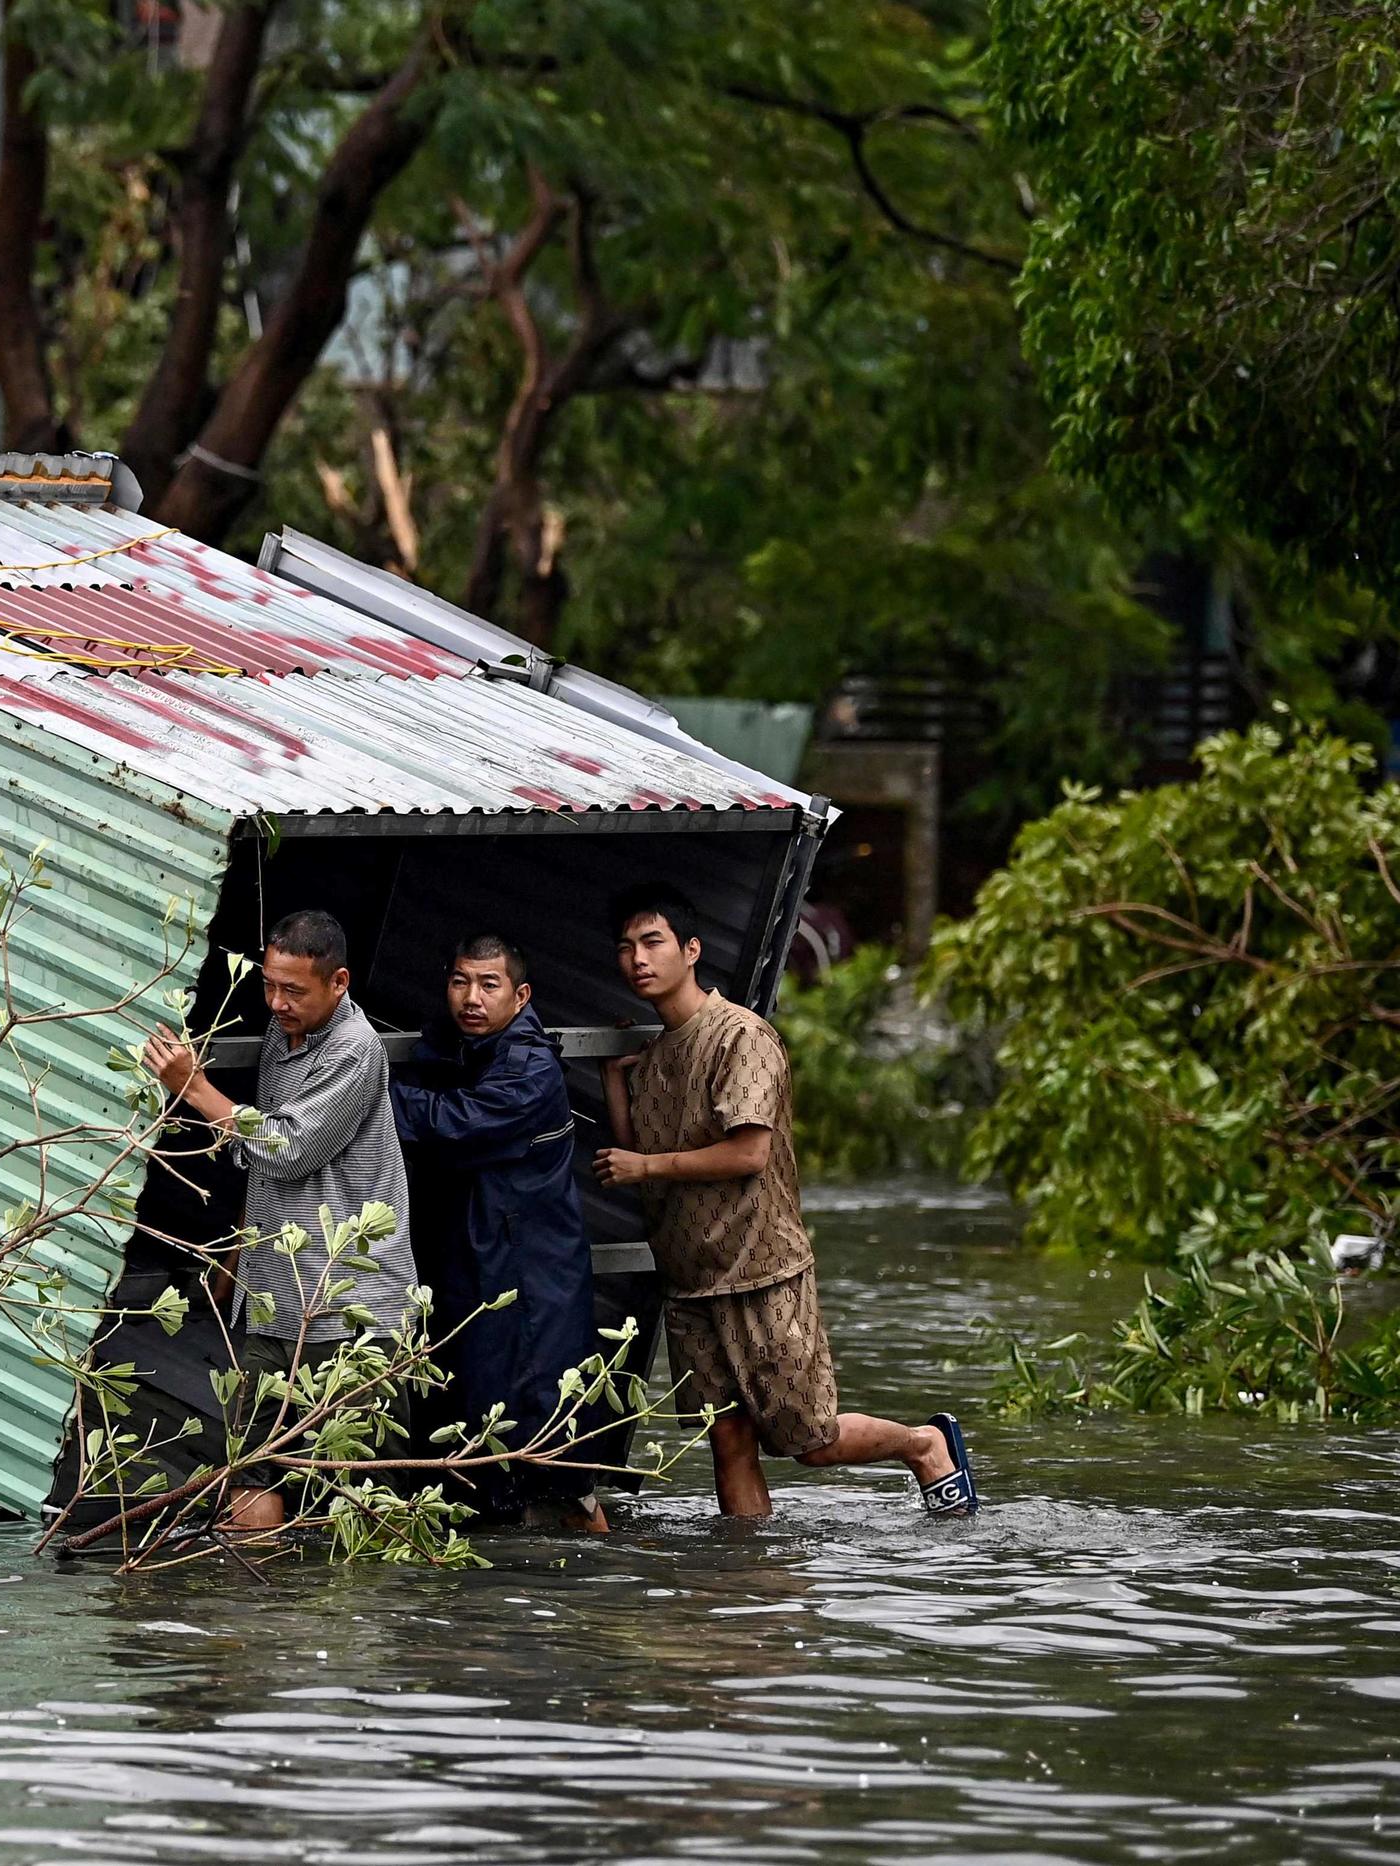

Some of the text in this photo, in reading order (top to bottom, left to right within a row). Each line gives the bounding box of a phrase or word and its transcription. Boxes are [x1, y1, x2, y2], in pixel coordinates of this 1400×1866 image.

[751, 1038, 757, 1051] U
[742, 1055, 747, 1066] B
[761, 1057, 766, 1069] B
[752, 1071, 758, 1083] U
[662, 1080, 668, 1093] U
[691, 1078, 698, 1090] U
[742, 1087, 749, 1098] B
[733, 1103, 760, 1116] U U
[643, 1112, 698, 1127] U U U
[683, 1129, 690, 1142] B
[760, 1178, 766, 1190] B
[698, 1194, 704, 1206] B
[690, 1197, 759, 1224] U U U U
[704, 1227, 710, 1239] B
[724, 1221, 730, 1234] B
[716, 1230, 765, 1252] U U U
[749, 1243, 774, 1261] B B
[709, 1274, 716, 1286] U
[739, 1267, 747, 1279] U
[761, 1262, 767, 1275] U
[763, 1290, 792, 1305] U U
[794, 1289, 800, 1302] B
[720, 1312, 726, 1325] B
[776, 1308, 782, 1321] B
[732, 1328, 773, 1342] U U U
[804, 1322, 810, 1335] B
[698, 1338, 705, 1350] U
[759, 1343, 788, 1359] B B
[733, 1358, 802, 1377] U U U
[764, 1381, 771, 1393] B
[787, 1376, 794, 1390] B
[826, 1385, 833, 1397] B
[778, 1392, 808, 1409] U U
[823, 1405, 831, 1417] U
[809, 1425, 816, 1437] U
[821, 1425, 827, 1437] B
